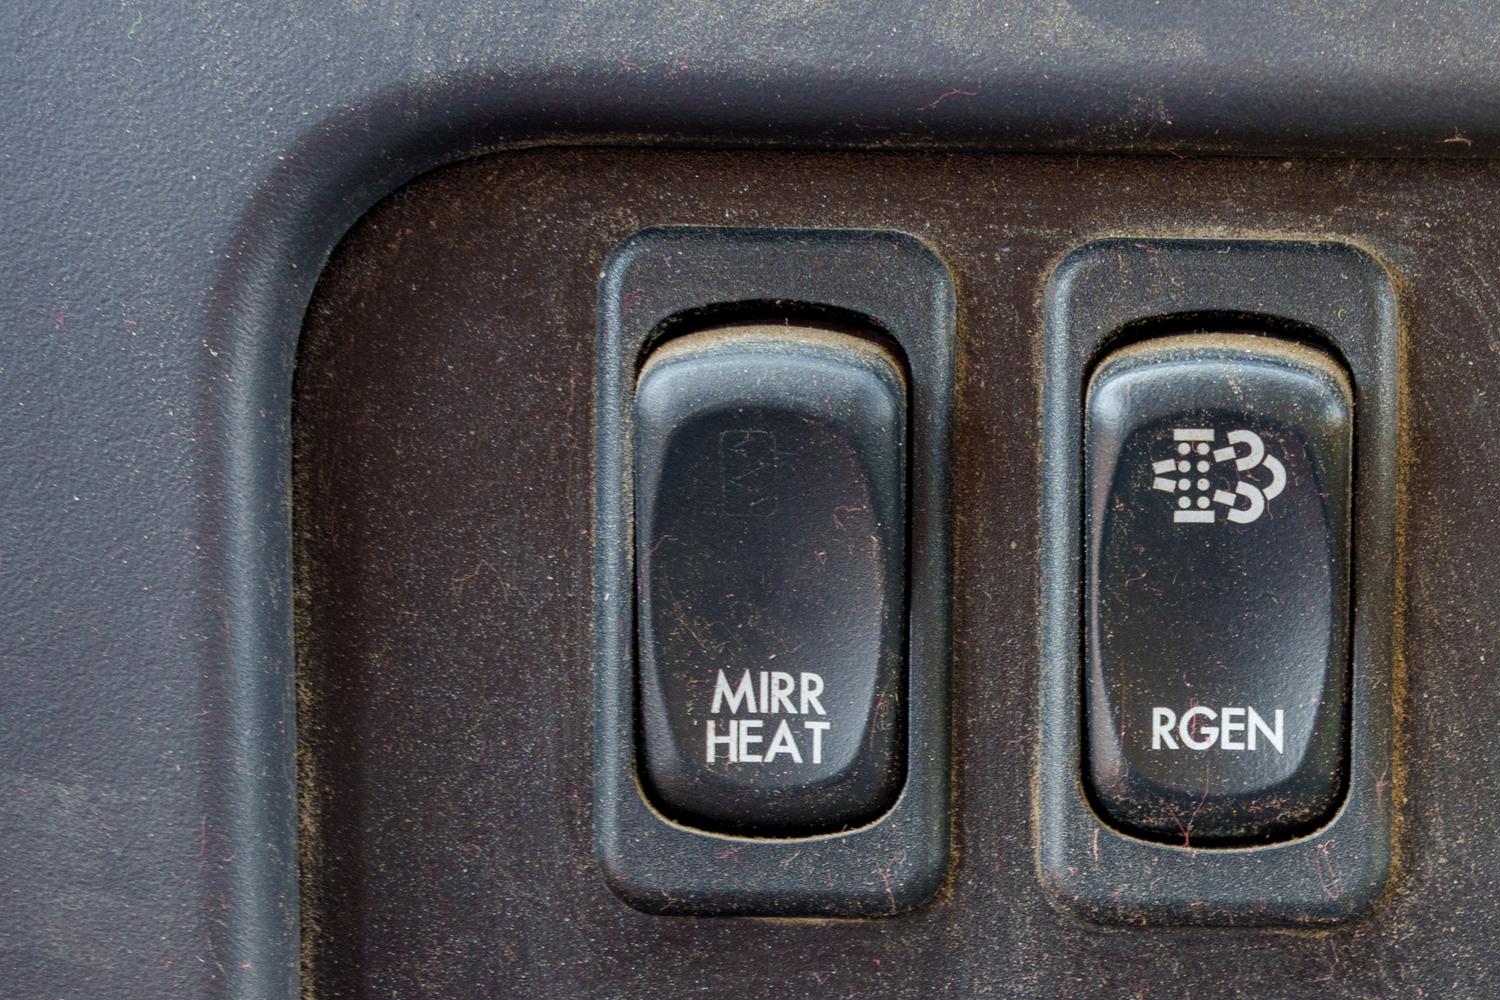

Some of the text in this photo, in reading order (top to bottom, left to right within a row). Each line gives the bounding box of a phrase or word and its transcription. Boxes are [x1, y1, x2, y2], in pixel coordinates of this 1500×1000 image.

[710, 669, 826, 716] MIRR
[706, 719, 831, 765] HEAT
[1151, 705, 1284, 754] RGEN
